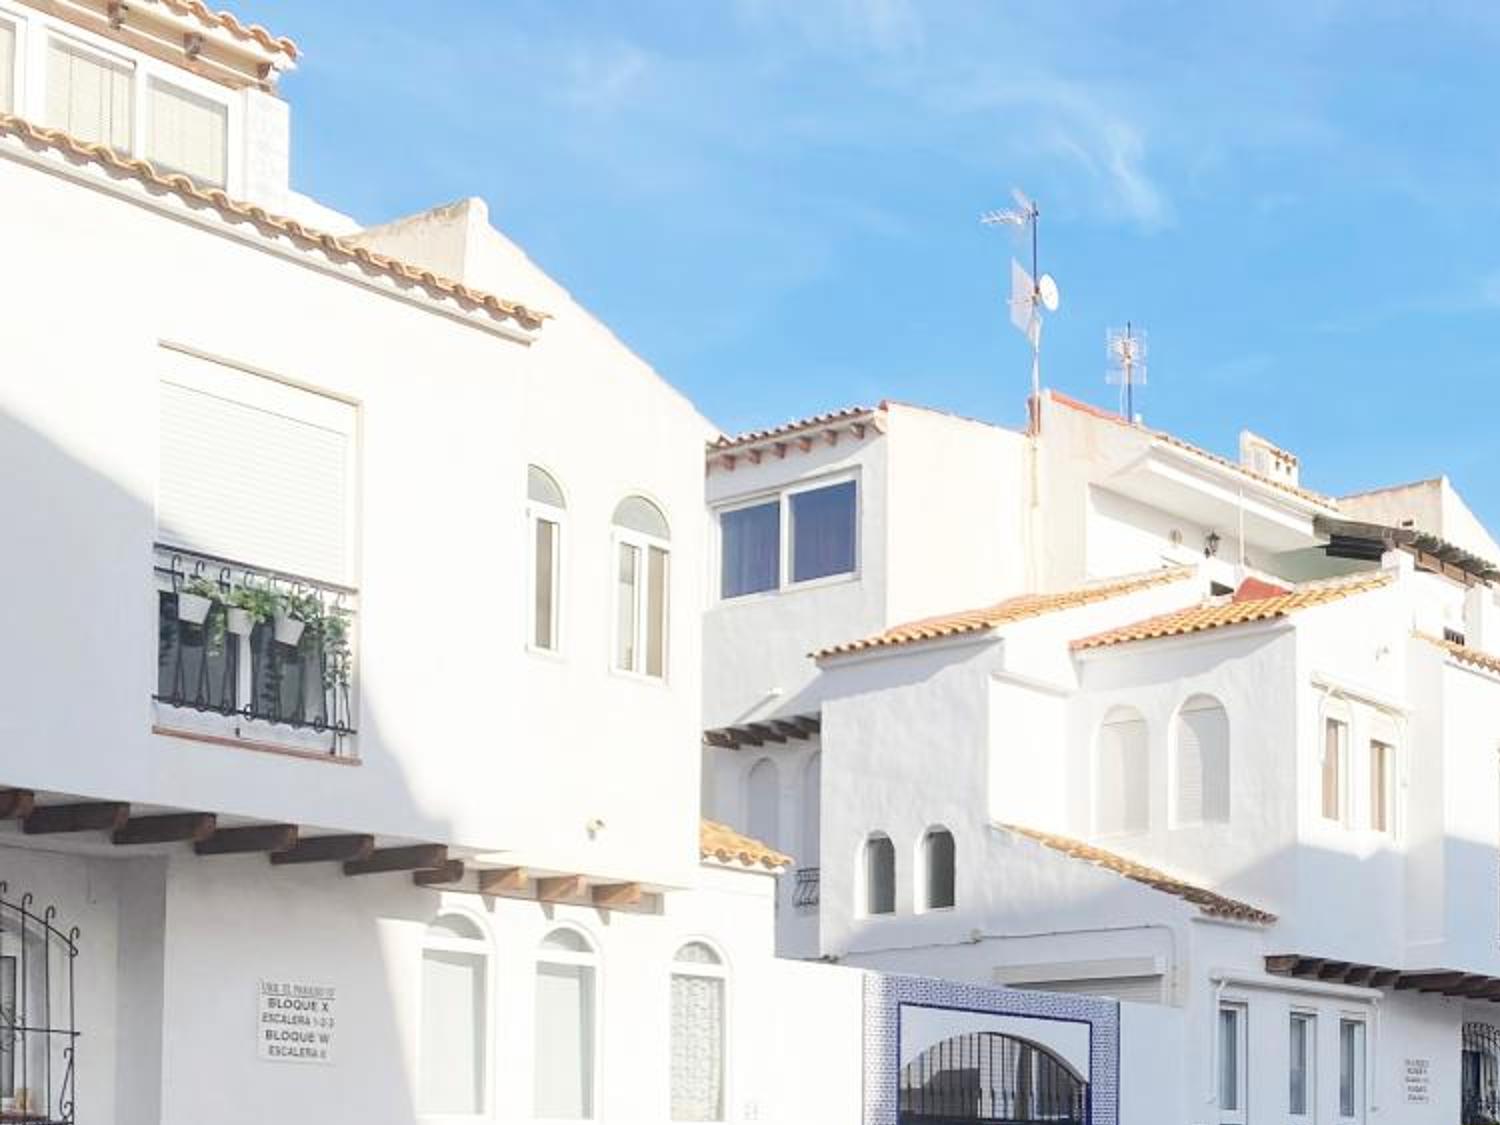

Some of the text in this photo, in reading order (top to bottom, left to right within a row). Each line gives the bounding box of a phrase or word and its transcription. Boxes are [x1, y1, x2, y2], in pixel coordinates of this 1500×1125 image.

[267, 997, 329, 1012] BLOQUE X
[265, 1029, 315, 1043] BLOQUE
[268, 1045, 318, 1057] ESCALERA
